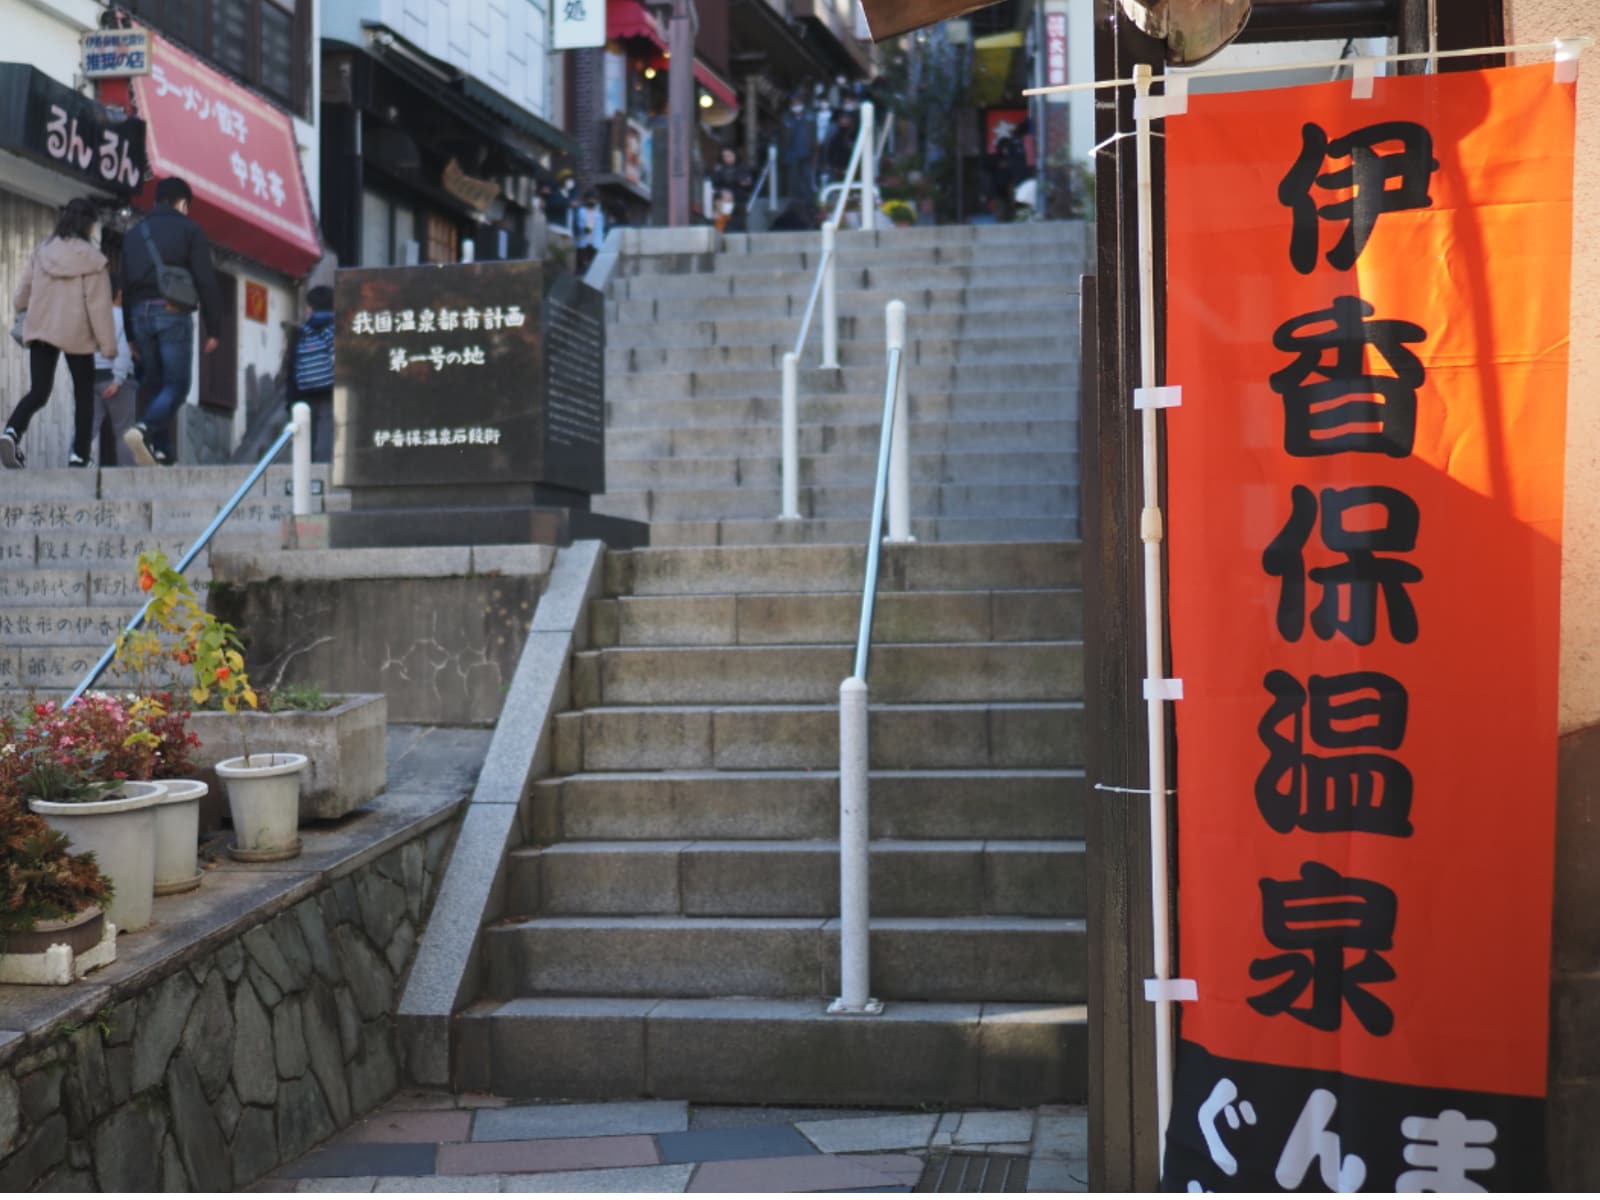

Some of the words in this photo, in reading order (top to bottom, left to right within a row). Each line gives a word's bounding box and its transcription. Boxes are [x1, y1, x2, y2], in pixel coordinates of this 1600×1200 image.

[351, 305, 526, 335] 我国温泉都市計画
[388, 345, 486, 373] 第一号の地
[1247, 121, 1440, 1038] 伊香保温泉
[1198, 1078, 1498, 1193] ぐんま
